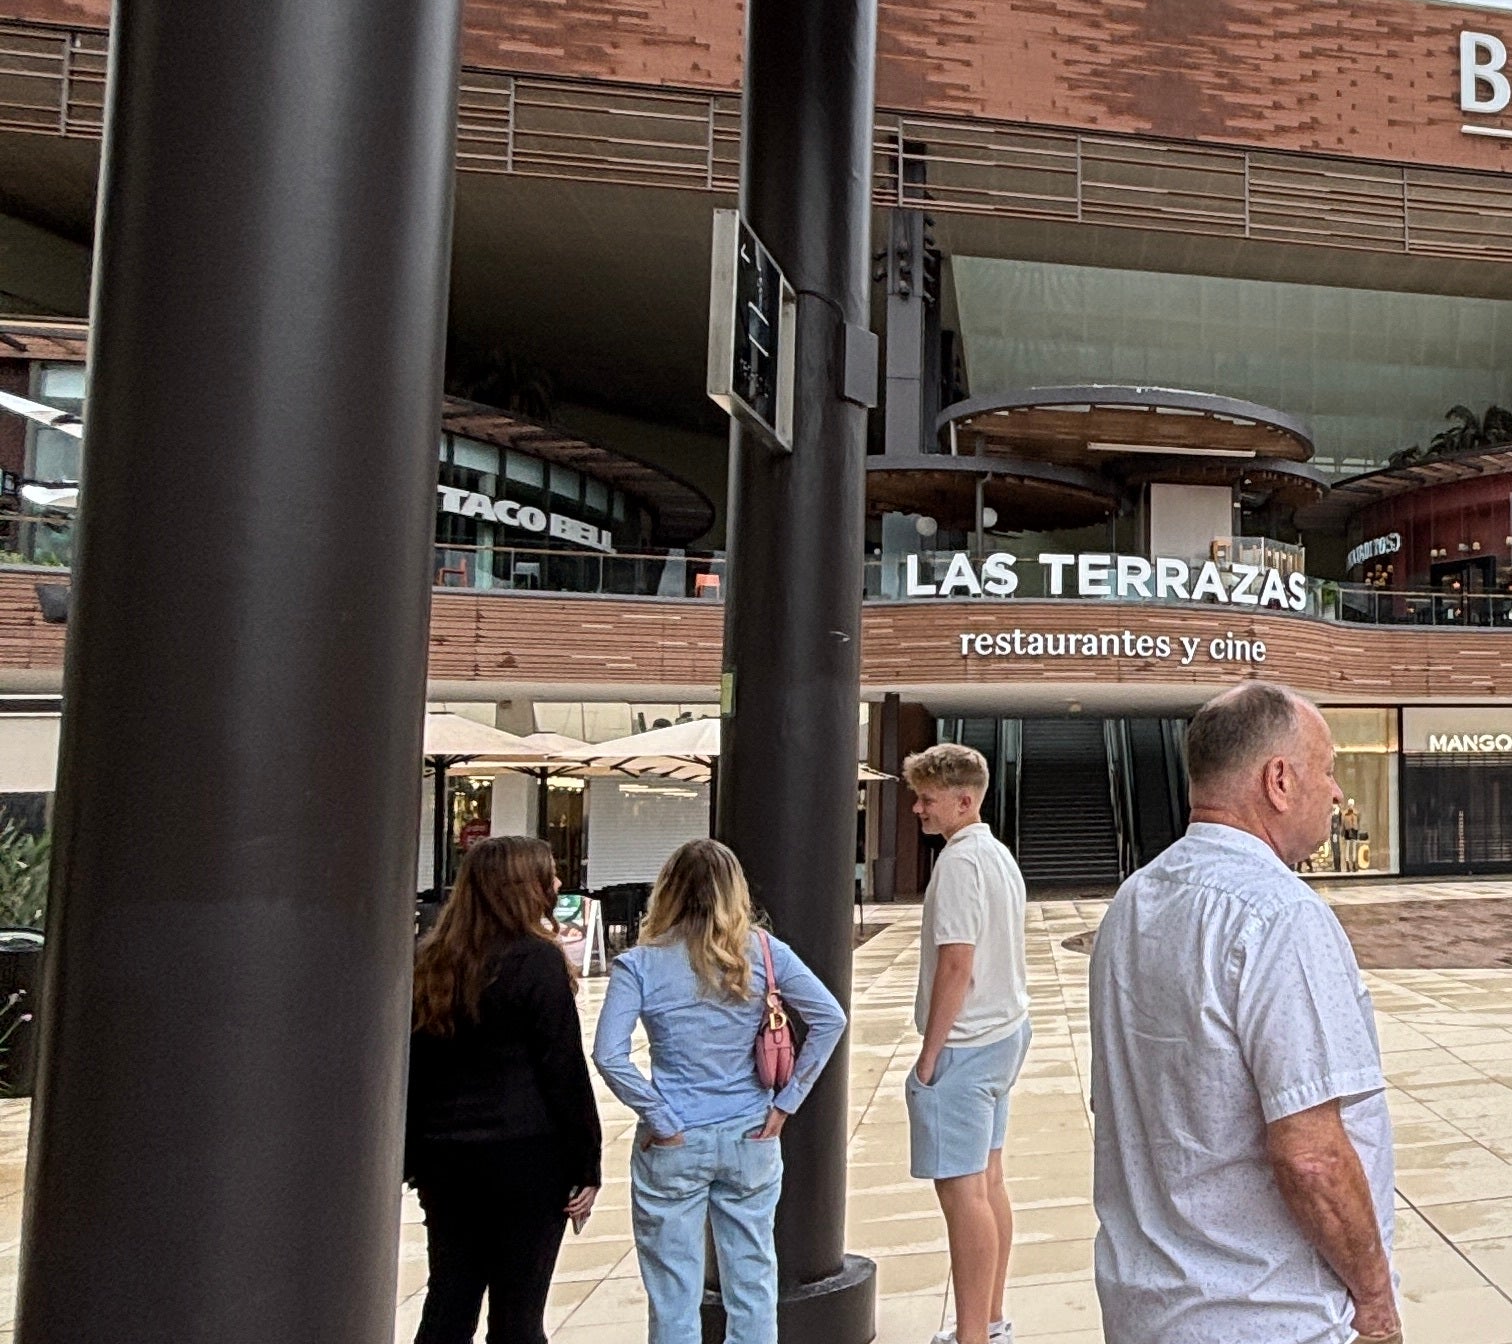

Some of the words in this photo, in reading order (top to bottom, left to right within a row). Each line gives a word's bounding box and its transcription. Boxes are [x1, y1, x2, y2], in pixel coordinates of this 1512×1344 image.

[437, 484, 547, 532] TACO
[550, 513, 614, 553] BELL
[906, 552, 1019, 597] LAS
[1039, 553, 1307, 611] TERRAZAS
[960, 628, 1171, 658] restaurantes
[1180, 636, 1201, 665] y
[1209, 631, 1267, 662] cine
[1429, 733, 1512, 753] MANGO
